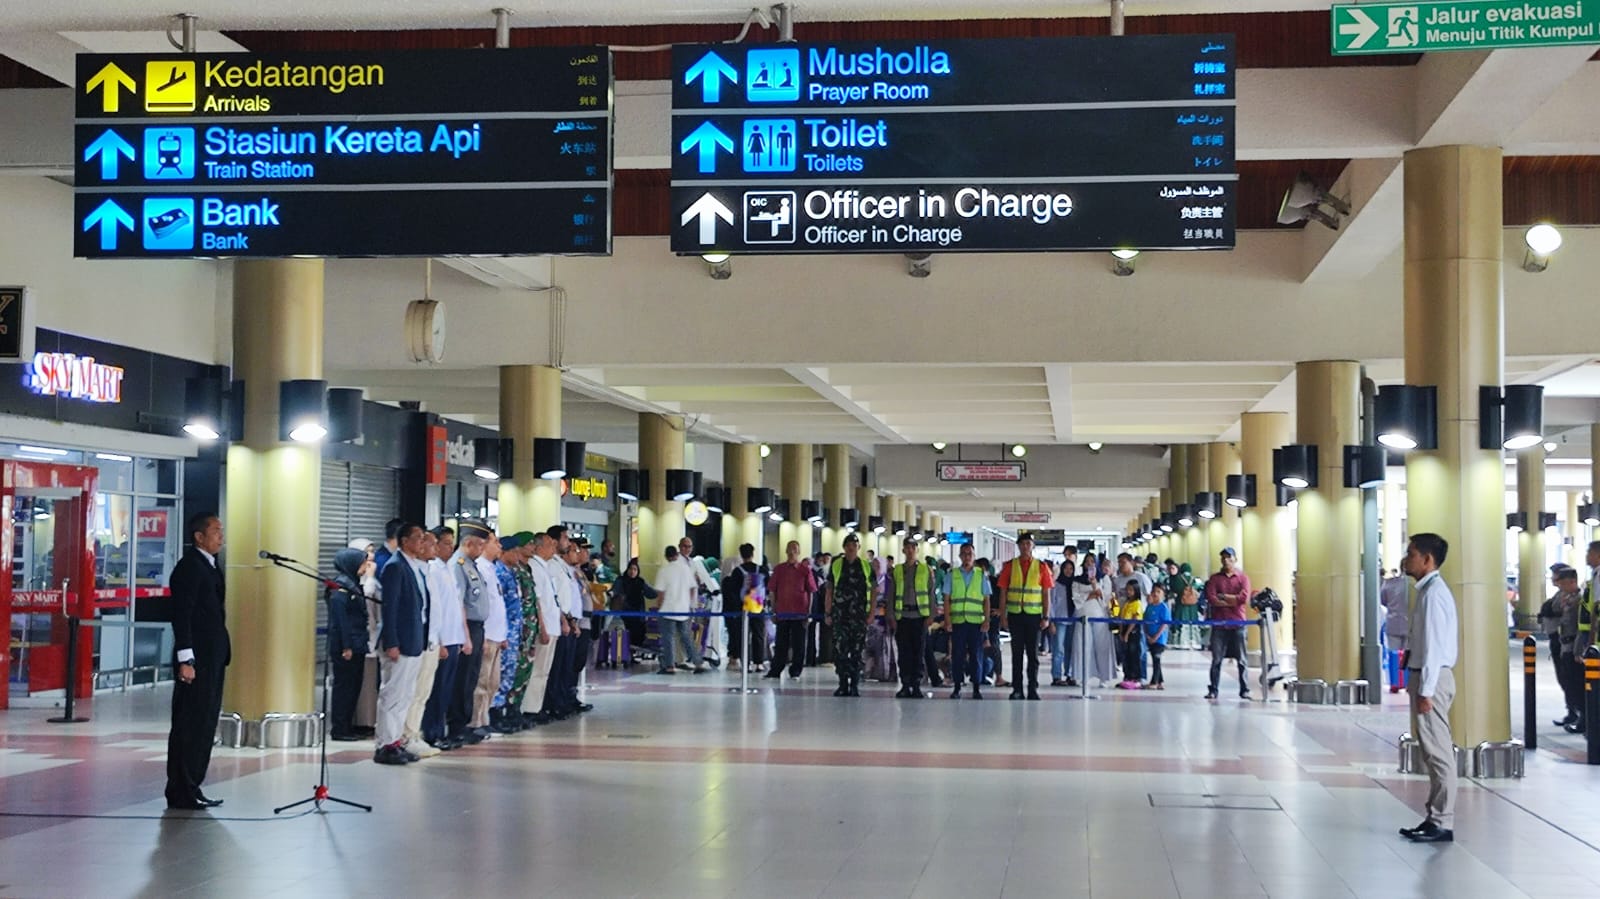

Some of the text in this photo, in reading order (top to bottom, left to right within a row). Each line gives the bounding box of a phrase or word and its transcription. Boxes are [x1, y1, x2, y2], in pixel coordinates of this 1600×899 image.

[1426, 1, 1583, 25] Jalur evakuasi
[1426, 29, 1485, 43] Menuju
[1490, 26, 1525, 40] Titik
[1530, 23, 1593, 40] Kumpul
[808, 46, 950, 76] Musholla
[205, 60, 384, 94] Kedatangan
[204, 95, 271, 112] Arrivals
[809, 82, 929, 104] Prayer Room
[204, 123, 480, 158] Stasiun Kereta Api
[804, 120, 887, 148] Toilet
[204, 160, 314, 178] Train Station
[804, 154, 863, 172] Toilets
[1195, 157, 1223, 167] トイレ
[203, 198, 280, 226] Bank
[750, 198, 768, 207] OIC
[804, 188, 1073, 223] Officer in Charge
[202, 232, 249, 249] Bank
[804, 225, 962, 246] Officer in Charge
[36, 353, 124, 403] SKY MART
